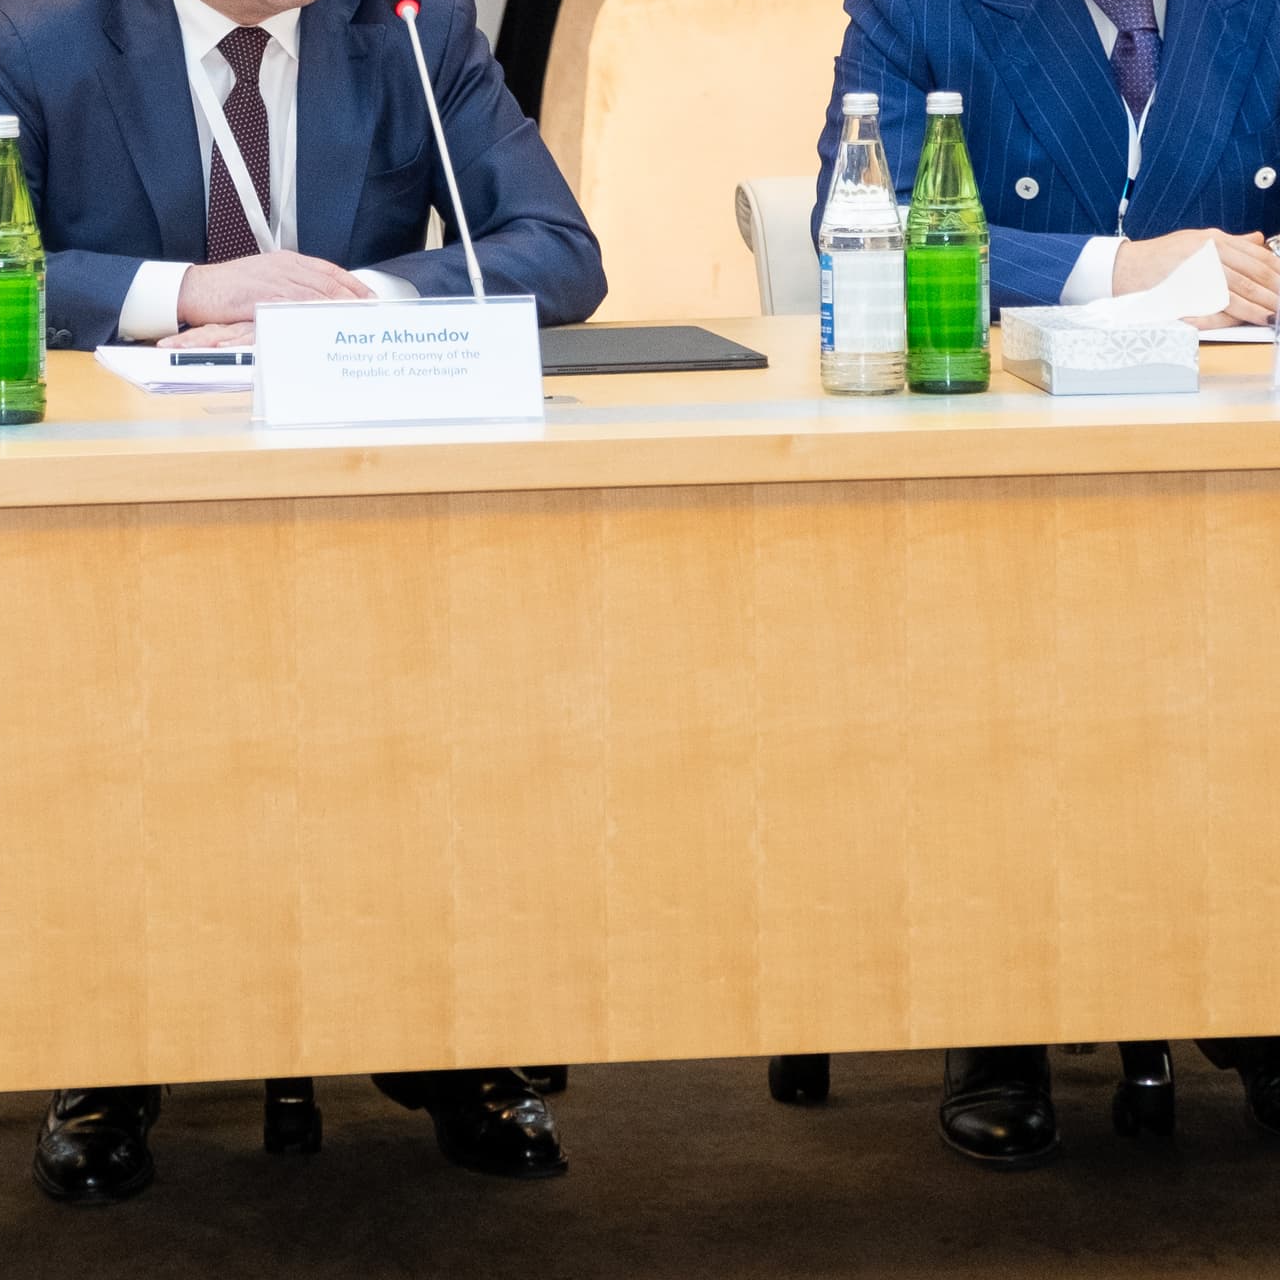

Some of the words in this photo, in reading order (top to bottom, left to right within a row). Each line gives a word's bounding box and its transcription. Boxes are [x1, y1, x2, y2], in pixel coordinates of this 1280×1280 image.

[334, 330, 376, 345] Anar
[380, 327, 470, 344] Akhundov
[326, 351, 374, 363] Ministry
[376, 351, 389, 361] of
[391, 350, 443, 362] Economy
[446, 349, 458, 360] of
[461, 348, 481, 360] the
[341, 366, 391, 379] Republic
[393, 366, 405, 377] of
[408, 365, 469, 378] Azerbaijan
